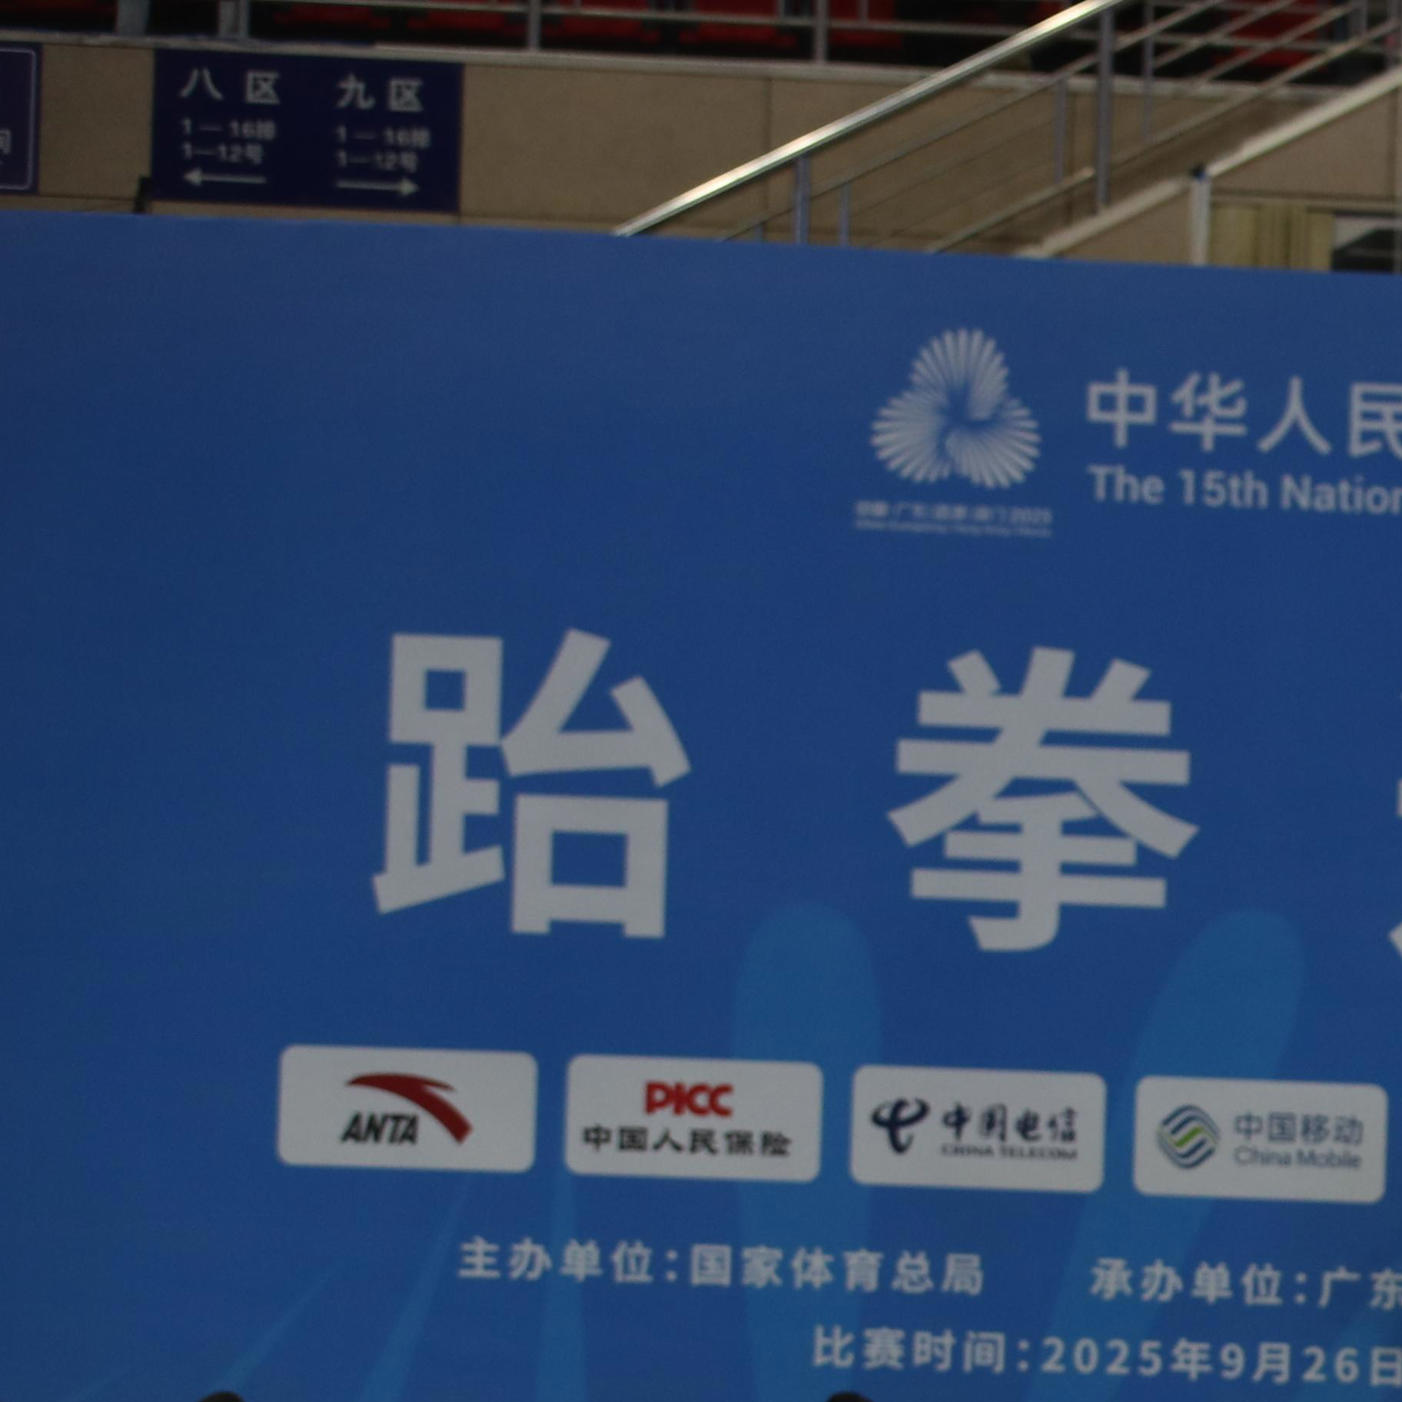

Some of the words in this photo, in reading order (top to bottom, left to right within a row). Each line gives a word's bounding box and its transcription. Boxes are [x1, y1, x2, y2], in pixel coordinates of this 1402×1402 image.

[1086, 464, 1164, 503] The
[1180, 469, 1268, 509] 15th
[643, 1080, 734, 1118] PICC
[341, 1112, 419, 1145] ANTA
[942, 1102, 1077, 1143] 中国电信
[1234, 1111, 1364, 1146] 中国移动
[582, 1125, 792, 1158] 中国人民保险
[1234, 1146, 1292, 1168] China
[1299, 1149, 1362, 1170] Mobile
